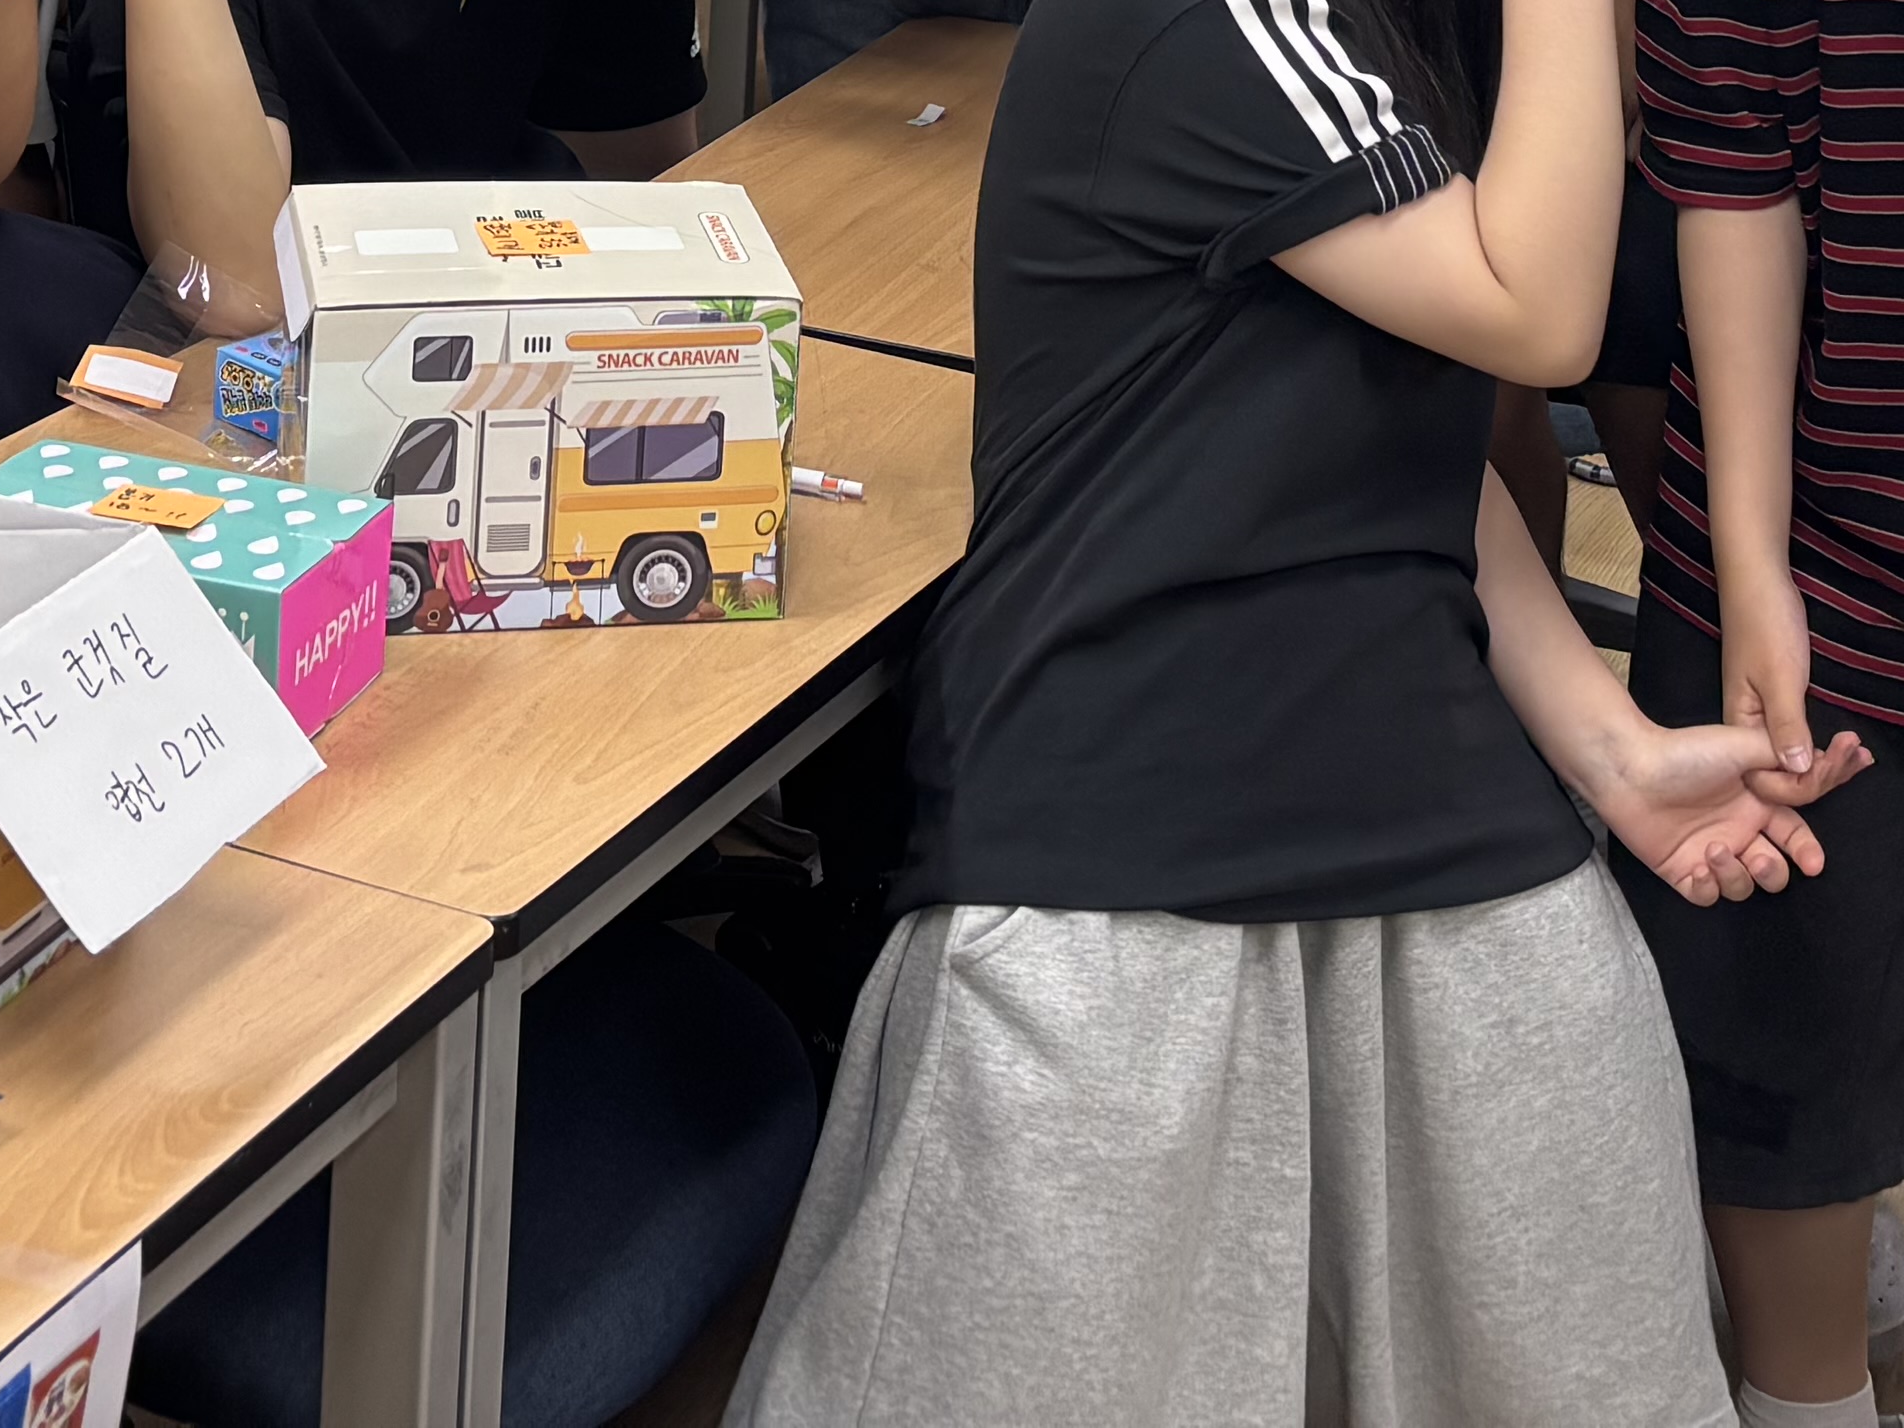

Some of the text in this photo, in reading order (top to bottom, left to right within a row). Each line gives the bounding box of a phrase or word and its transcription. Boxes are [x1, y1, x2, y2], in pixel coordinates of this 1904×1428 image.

[596, 348, 740, 369] SNACK CARAVAN
[294, 579, 378, 686] HAPPY!!
[105, 713, 225, 823] 엽전 2개
